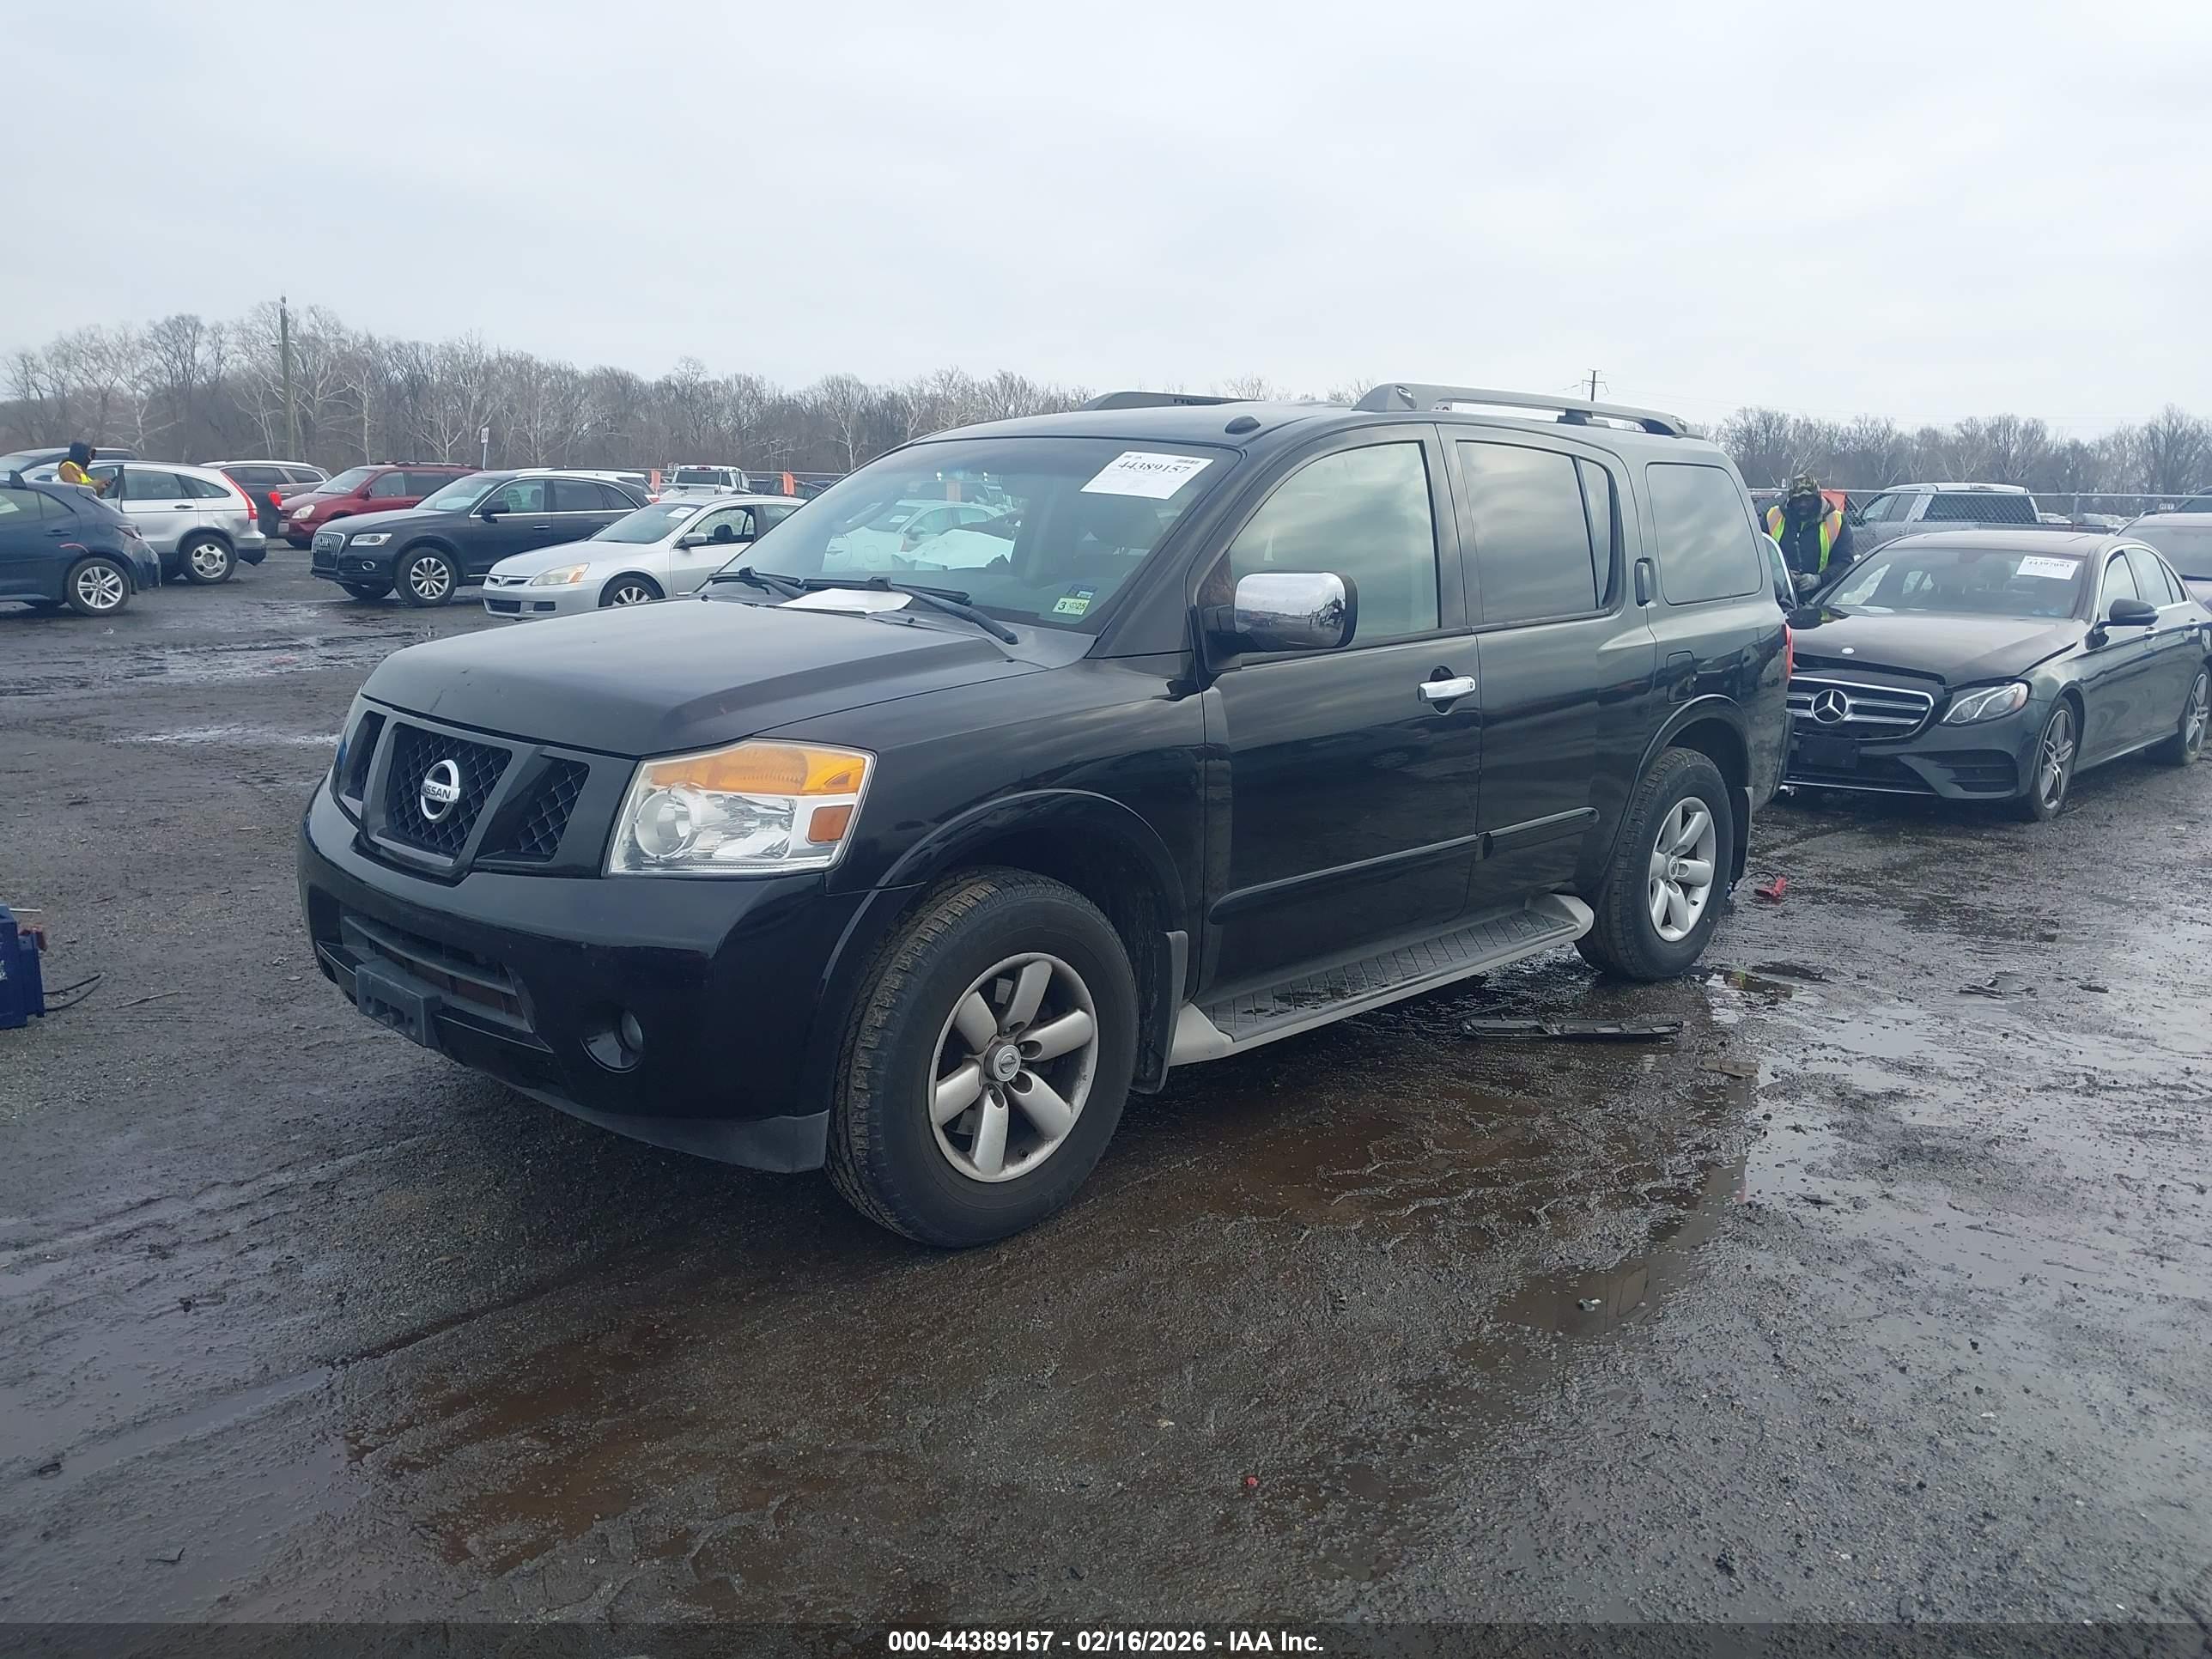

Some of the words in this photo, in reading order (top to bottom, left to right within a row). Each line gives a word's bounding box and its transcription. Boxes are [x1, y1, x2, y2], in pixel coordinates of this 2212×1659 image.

[1118, 460, 1191, 474] 44389157
[1058, 601, 1066, 611] 3
[421, 782, 452, 799] NISSAN
